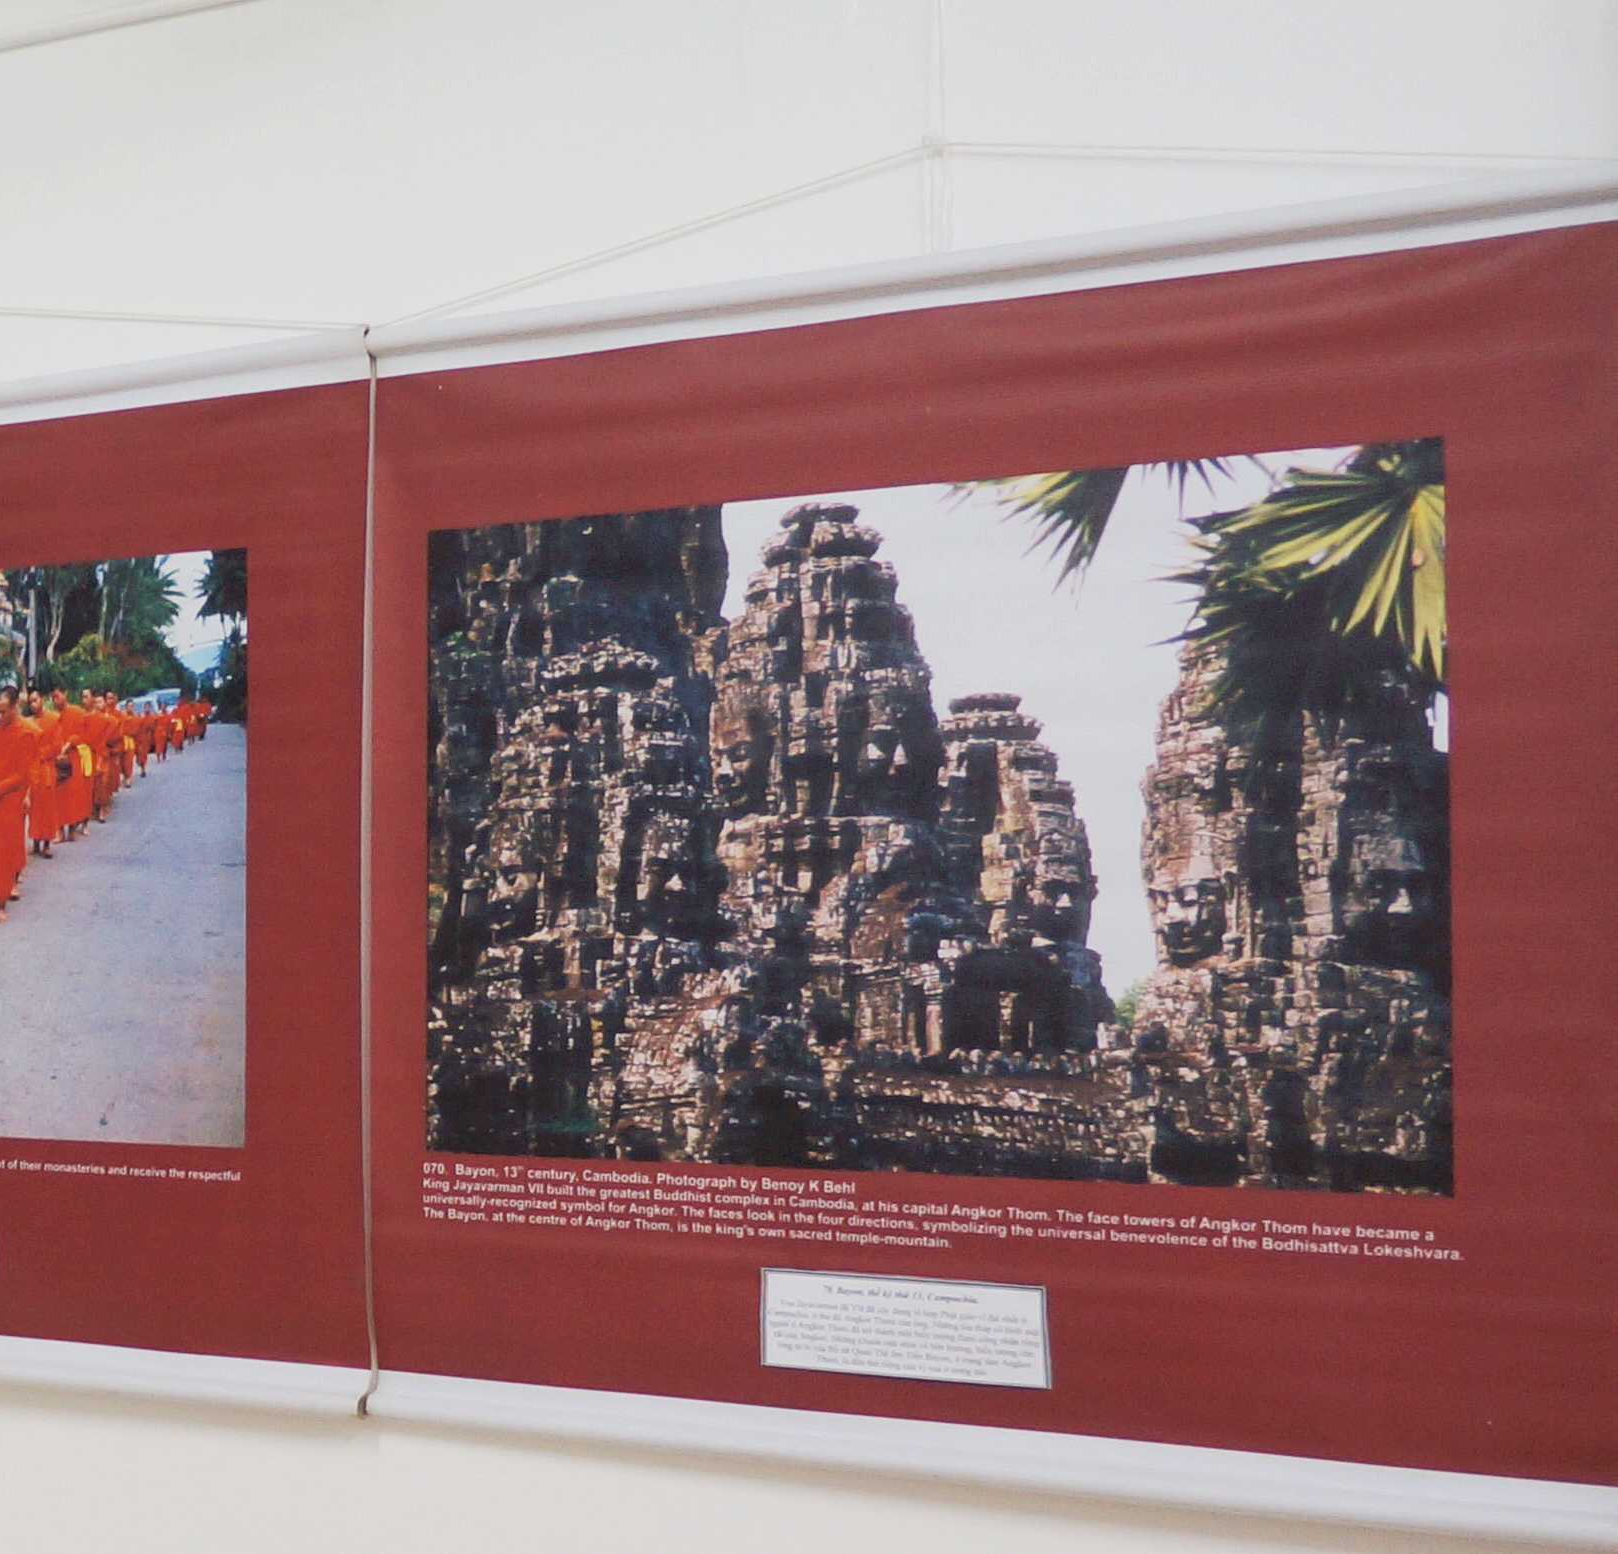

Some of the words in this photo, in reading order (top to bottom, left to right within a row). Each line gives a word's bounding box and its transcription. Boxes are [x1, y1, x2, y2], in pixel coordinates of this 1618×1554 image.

[454, 1162, 498, 1179] Bayon,
[526, 1168, 579, 1183] century,
[581, 1168, 652, 1184] Cambodia.
[655, 1172, 737, 1190] Photograph
[739, 1176, 758, 1192] by
[760, 1176, 805, 1194] Benoy
[808, 1179, 819, 1192] K
[822, 1179, 856, 1194] Behl
[422, 1177, 450, 1192] King
[453, 1179, 525, 1193] Jayavarman
[527, 1182, 545, 1194] VII
[545, 1183, 574, 1196] built
[576, 1185, 596, 1197] the
[598, 1188, 650, 1200] greatest
[652, 1187, 712, 1203] Buddhist
[713, 1193, 770, 1207] complex
[772, 1194, 786, 1206] in
[787, 1194, 859, 1211] Cambodia,
[861, 1200, 875, 1211] at
[877, 1200, 899, 1213] his
[901, 1203, 948, 1216] capital
[950, 1203, 1002, 1220] Angkor
[1007, 1206, 1050, 1220] Thom.
[1055, 1208, 1084, 1223] The
[1086, 1210, 1120, 1225] face
[1122, 1213, 1176, 1228] towers
[1179, 1215, 1196, 1228] of
[1198, 1216, 1257, 1234] Angkor
[1261, 1219, 1308, 1234] Thom
[1311, 1222, 1351, 1237] have
[1354, 1224, 1420, 1240] became
[1424, 1230, 1435, 1241] a
[422, 1205, 445, 1219] The
[446, 1207, 488, 1223] Bayon,
[491, 1211, 504, 1222] at
[505, 1211, 526, 1223] the
[528, 1214, 567, 1225] centre
[569, 1214, 583, 1226] of
[585, 1215, 630, 1231] Angkor
[633, 1217, 673, 1232] Thom,
[676, 1220, 689, 1232] is
[691, 1221, 712, 1234] the
[714, 1222, 755, 1238] king's
[757, 1227, 786, 1237] own
[788, 1229, 833, 1241] sacred
[834, 1231, 952, 1247] temple-mountain.
[422, 1194, 557, 1211] universally-recognized
[559, 1200, 606, 1213] symbol
[607, 1200, 626, 1213] for
[628, 1202, 678, 1218] Angkor.
[680, 1204, 705, 1218] The
[707, 1206, 744, 1220] faces
[746, 1208, 775, 1221] look
[777, 1210, 791, 1222] in
[793, 1211, 814, 1224] the
[816, 1211, 844, 1225] four
[921, 1220, 1008, 1238] symbolizing
[1010, 1223, 1034, 1236] the
[1037, 1227, 1106, 1240] universal
[1109, 1229, 1207, 1246] benevolence
[1211, 1234, 1228, 1247] of
[1231, 1235, 1257, 1249] the
[1261, 1236, 1359, 1254] Bodhisattva
[1362, 1242, 1464, 1260] Lokeshvara.
